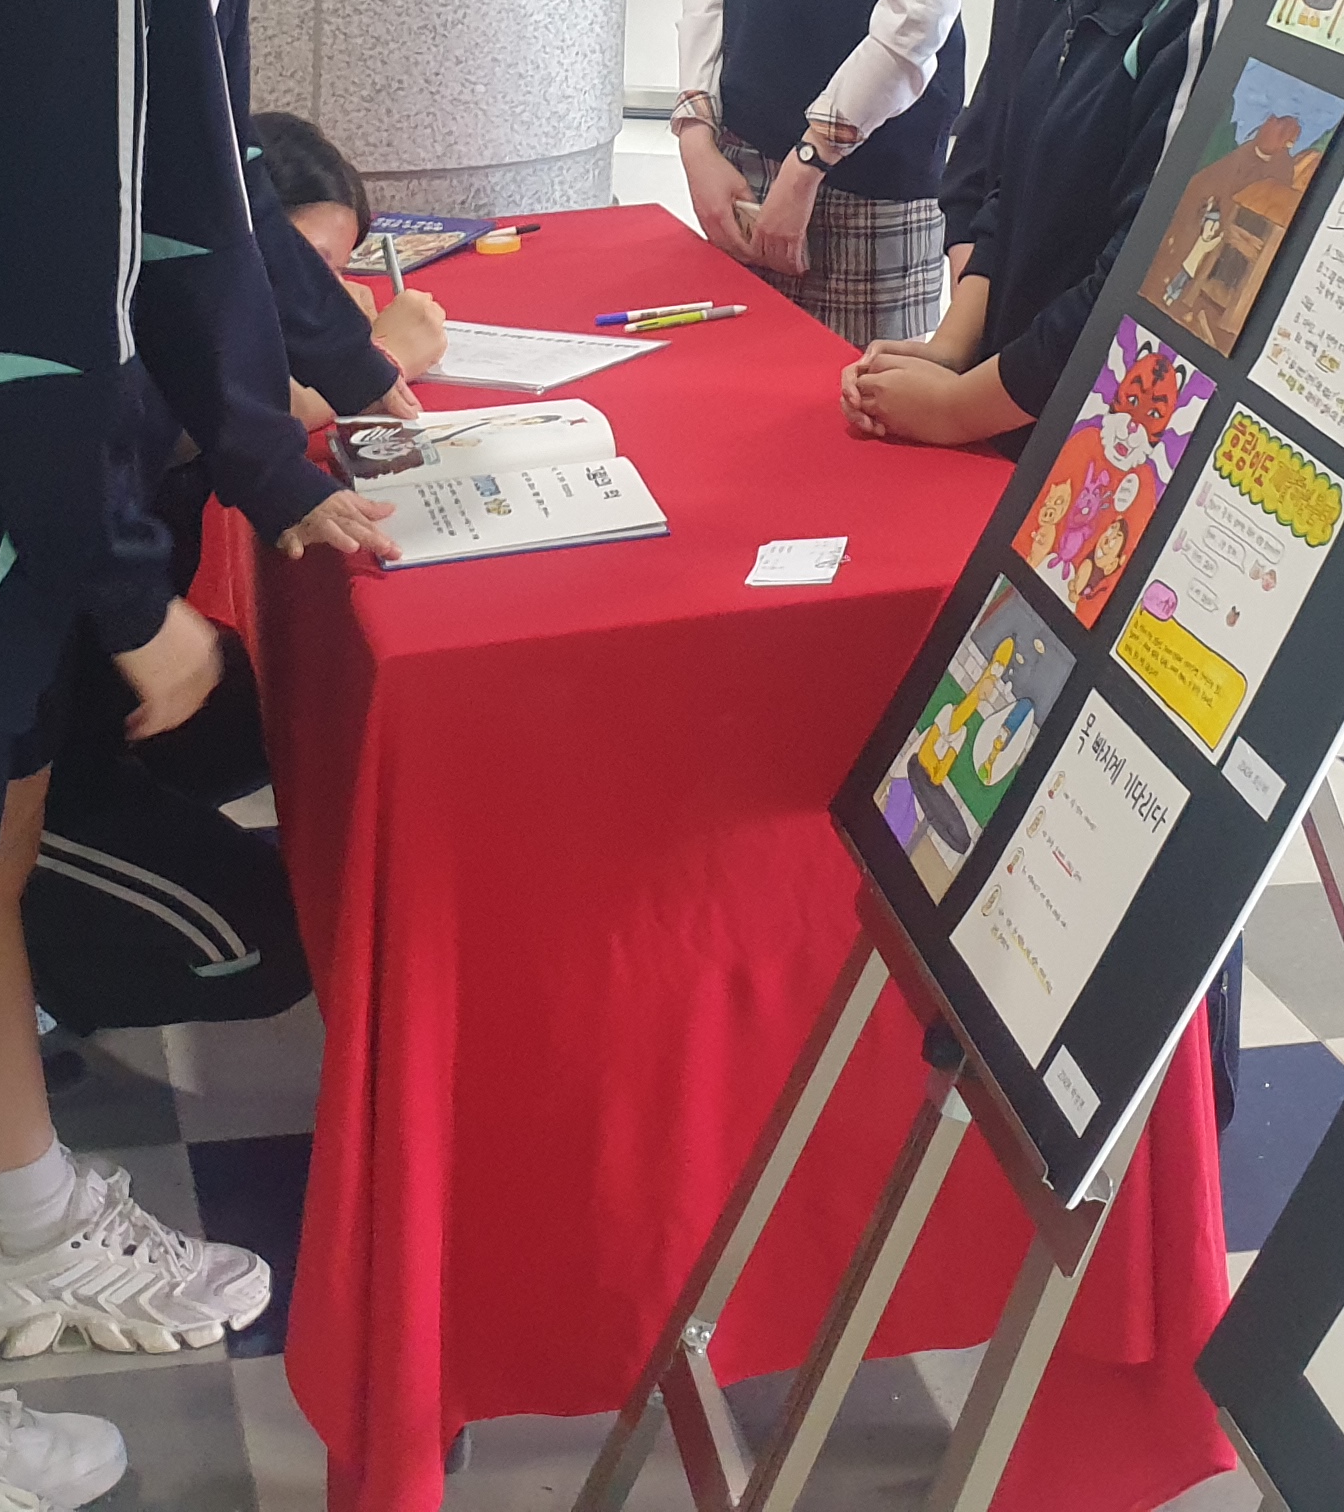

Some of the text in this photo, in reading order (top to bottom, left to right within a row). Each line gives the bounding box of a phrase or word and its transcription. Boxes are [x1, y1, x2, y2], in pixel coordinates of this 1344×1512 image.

[1077, 712, 1097, 755] 목
[1091, 731, 1127, 786] 빠지게
[1123, 771, 1169, 834] 기다리다
